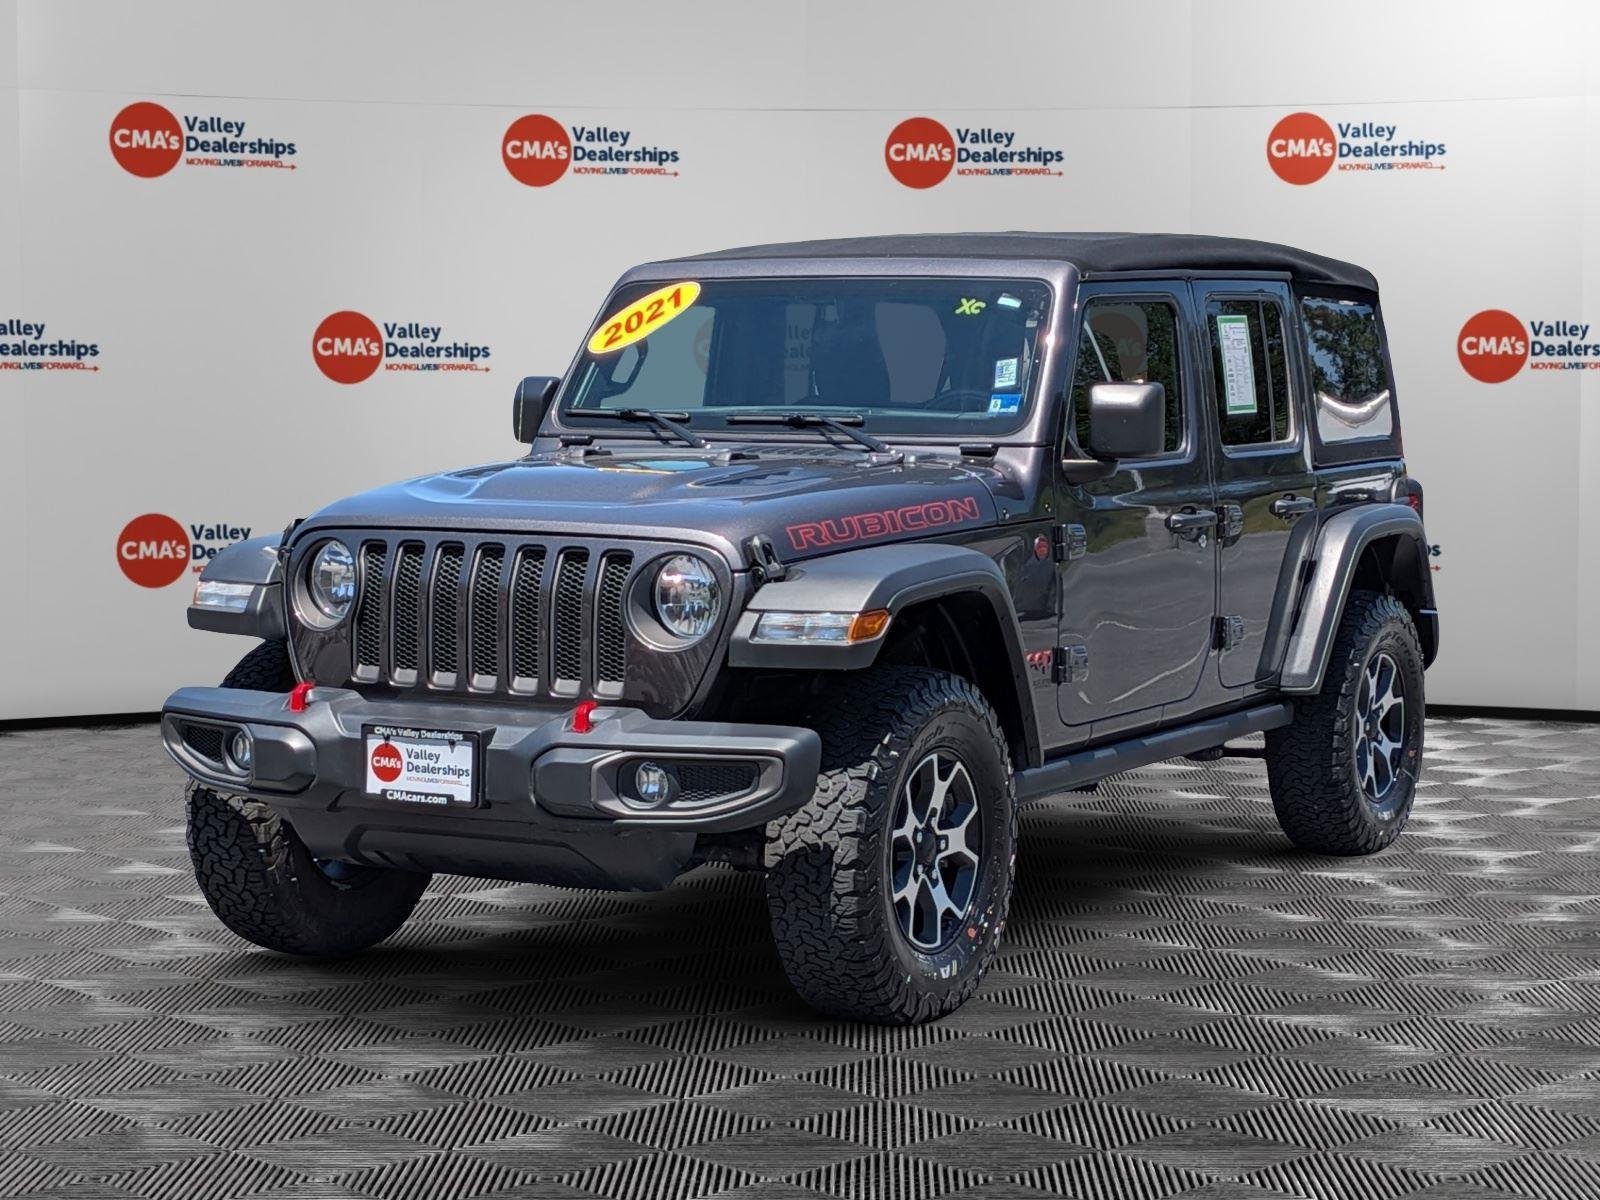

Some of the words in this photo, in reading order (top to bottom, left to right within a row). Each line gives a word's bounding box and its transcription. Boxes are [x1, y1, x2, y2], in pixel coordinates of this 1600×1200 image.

[184, 116, 245, 138] Valley
[572, 126, 630, 146] Valley
[1338, 122, 1396, 141] Valley
[114, 128, 180, 150] CMA's
[186, 136, 296, 158] Dealerships
[956, 128, 1015, 148] Valley
[1271, 138, 1333, 158] CMA's
[506, 140, 568, 160] CMA's
[573, 146, 679, 166] Dealerships
[889, 143, 952, 162] CMA's
[957, 148, 1064, 166] Dealerships
[1338, 141, 1446, 159] Dealerships
[603, 287, 681, 348] 2021
[0, 319, 45, 340] alley
[384, 322, 441, 342] Valley
[1530, 320, 1589, 340] Valley
[0, 340, 100, 360] ealerships
[316, 337, 380, 357] CMA's
[386, 342, 490, 361] Dealerships
[1461, 336, 1526, 356] CMA's
[1530, 340, 1600, 356] Dealers
[190, 524, 251, 540] Valley
[786, 497, 980, 550] RUBICON
[120, 540, 186, 560] CMA's
[398, 728, 420, 738] Valley
[372, 757, 402, 768] CMA's
[406, 748, 440, 762] Valley
[406, 762, 470, 779] Dealerships
[386, 790, 447, 804] CMAcars.com
